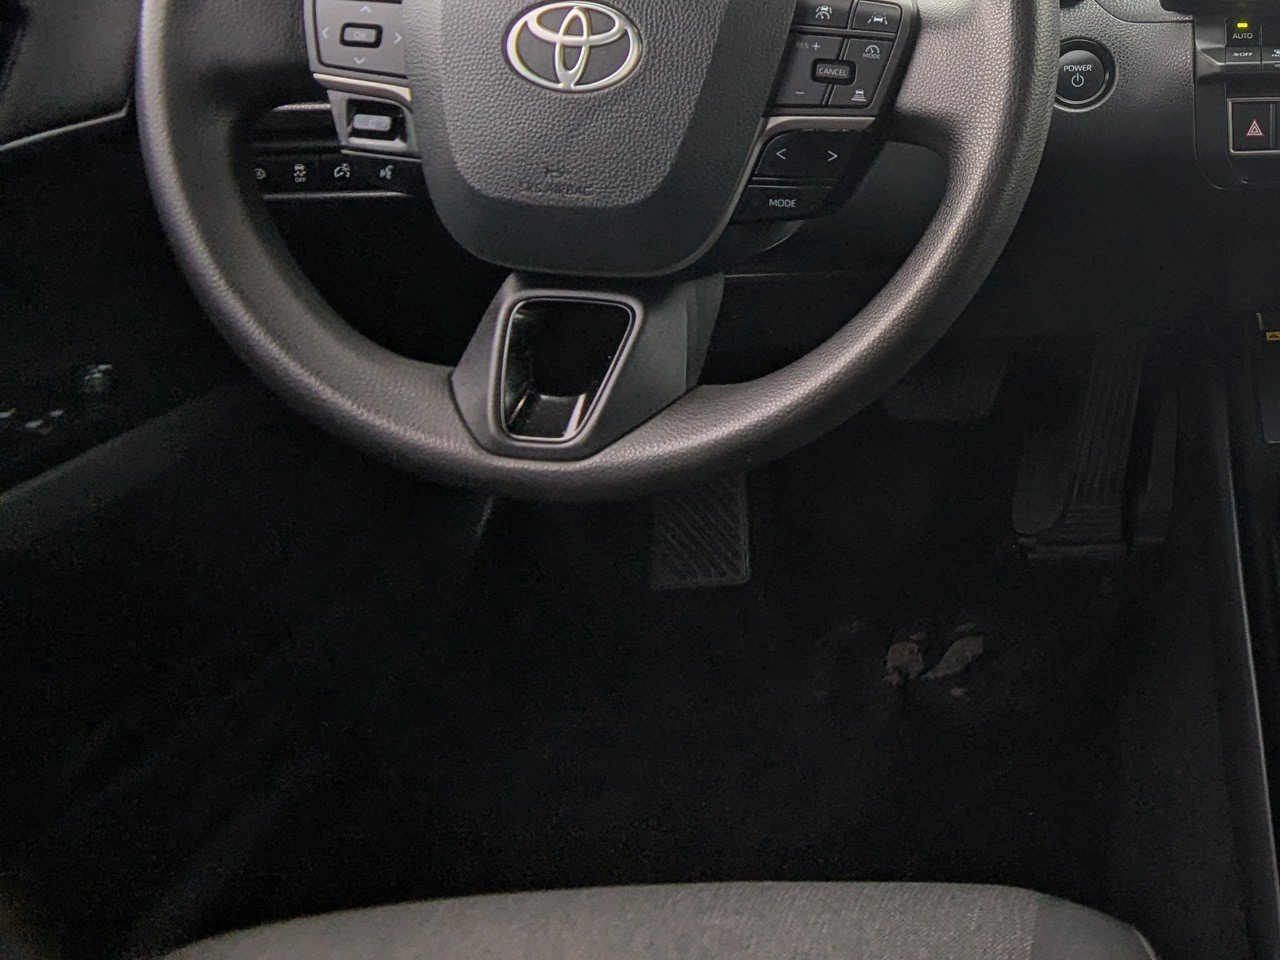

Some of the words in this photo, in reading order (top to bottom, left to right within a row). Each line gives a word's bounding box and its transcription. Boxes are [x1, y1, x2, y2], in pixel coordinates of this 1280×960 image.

[819, 67, 847, 77] CANCEL
[1063, 63, 1092, 72] POWER
[768, 198, 797, 208] MODE
